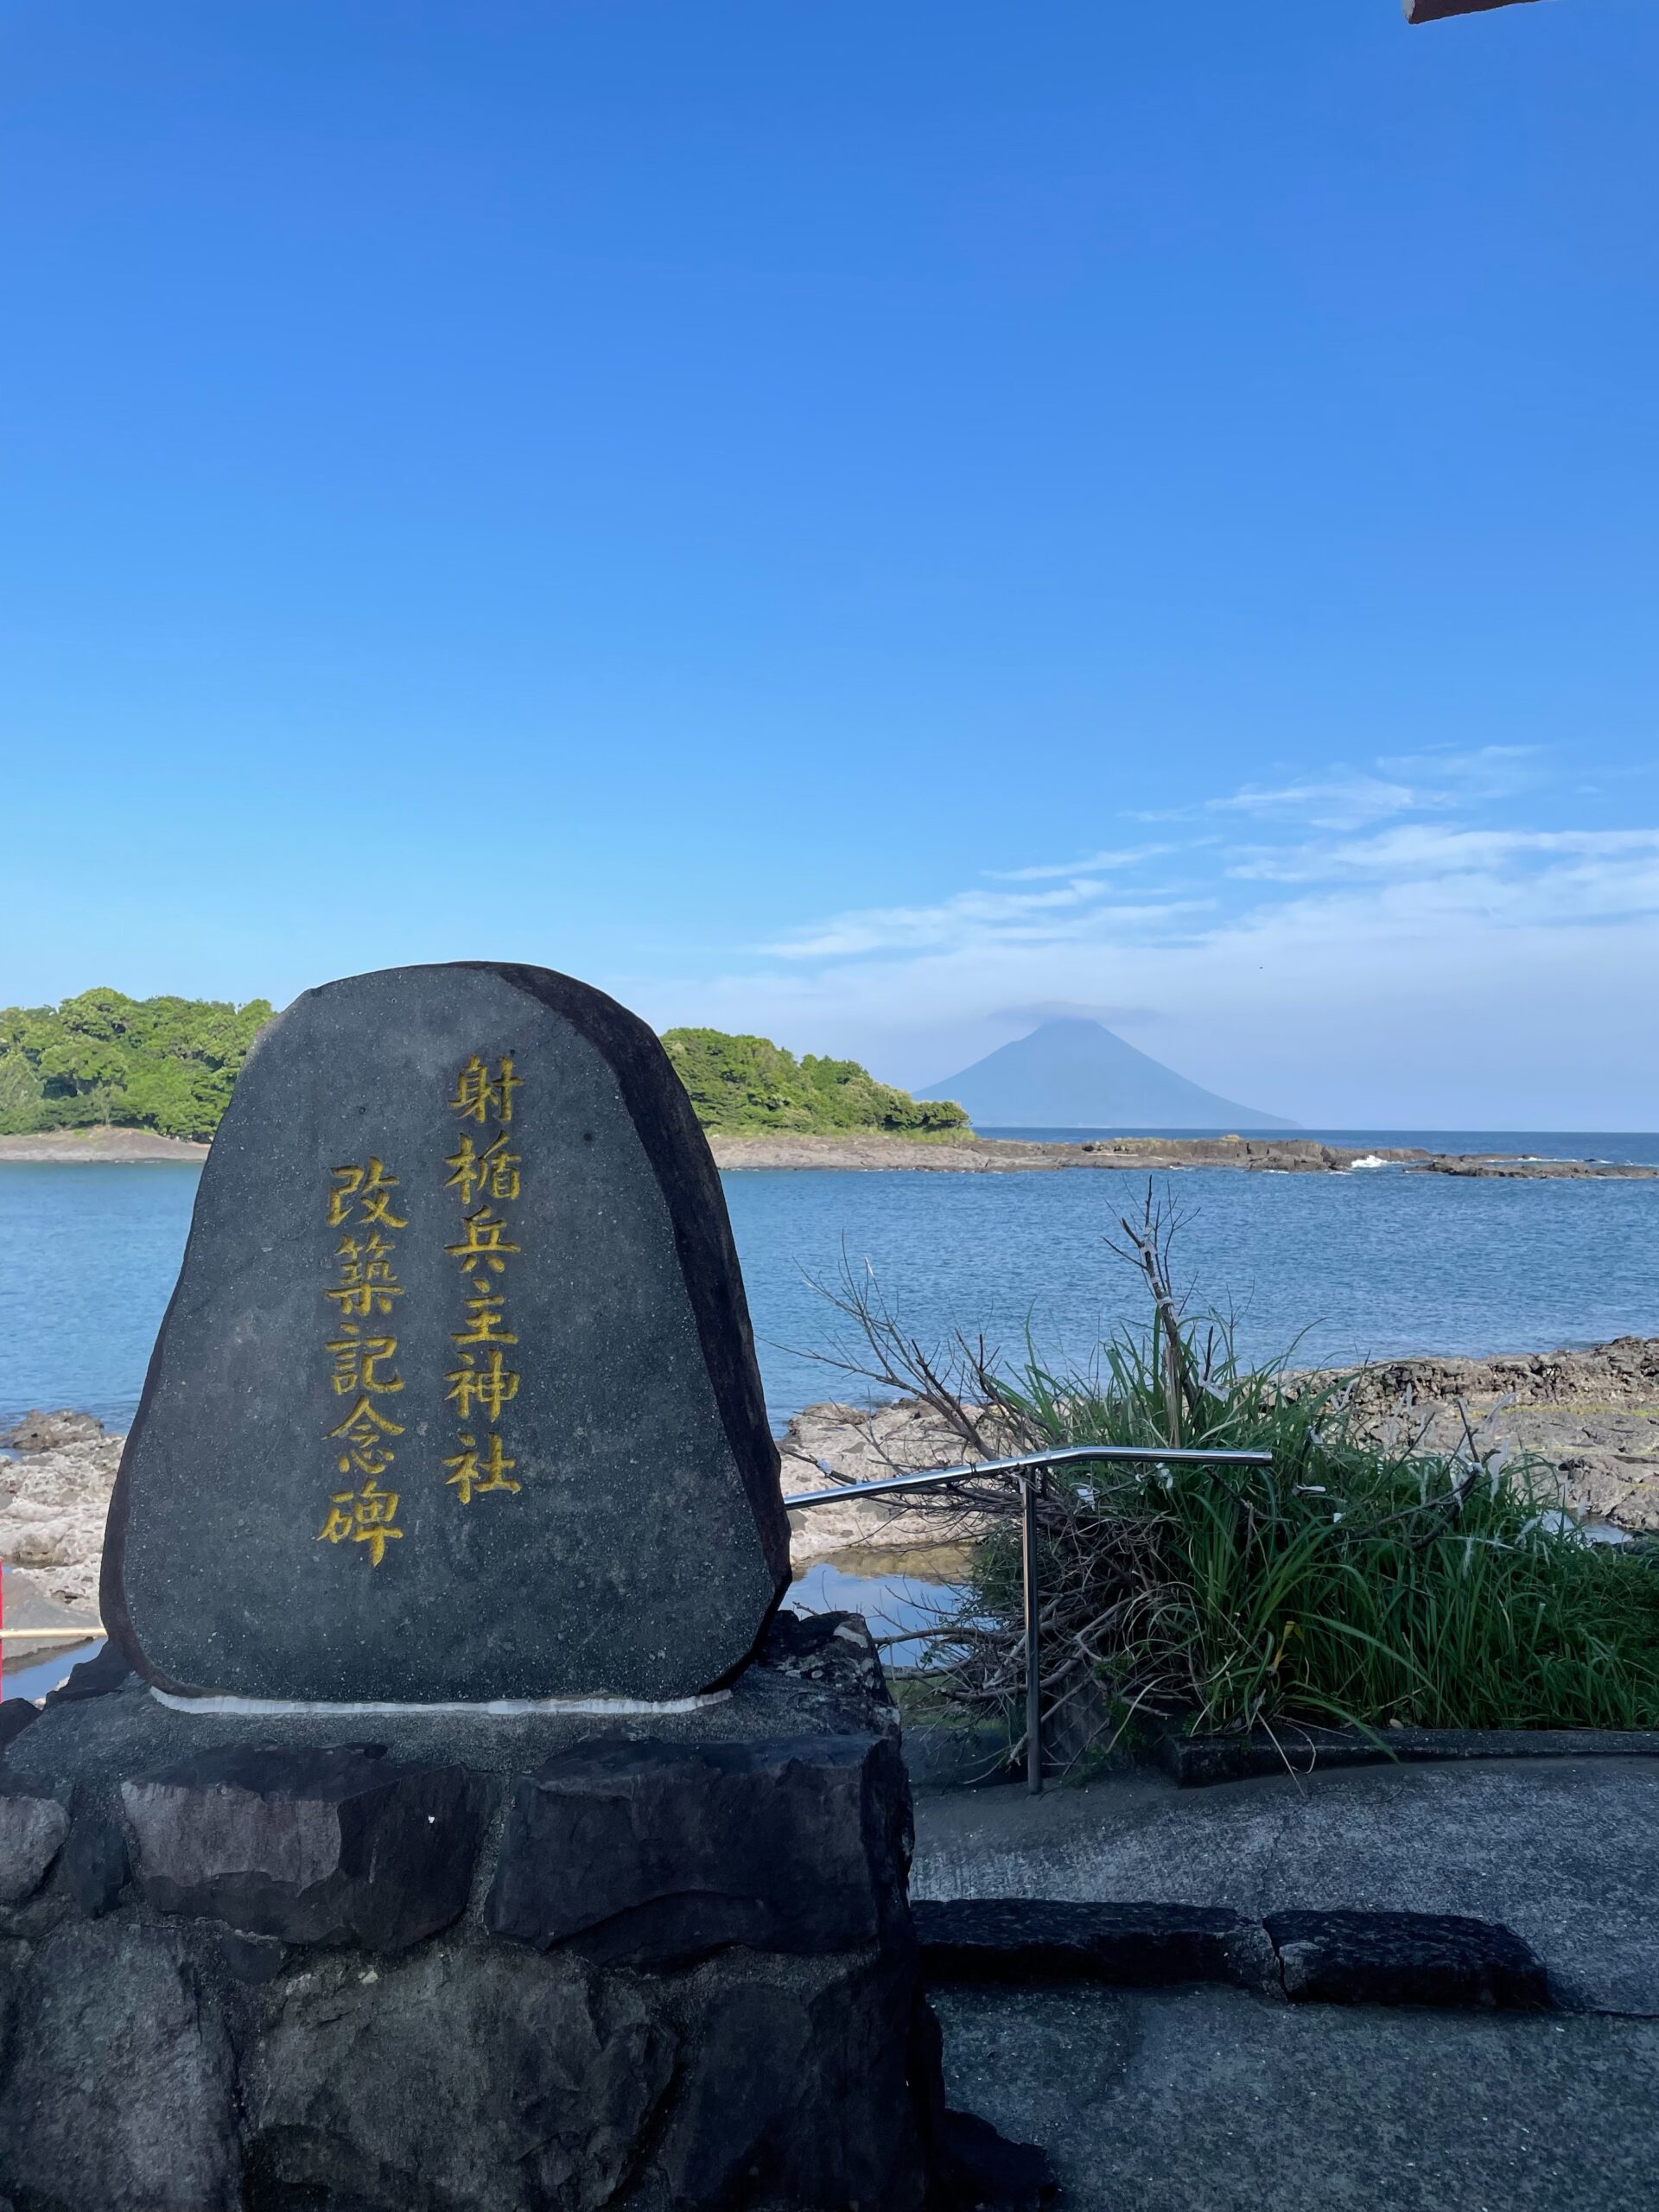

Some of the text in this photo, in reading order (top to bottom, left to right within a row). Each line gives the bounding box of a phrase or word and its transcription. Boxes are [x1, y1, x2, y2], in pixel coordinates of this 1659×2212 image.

[317, 1155, 408, 1567] 改築記念碑
[442, 1054, 524, 1505] 射楯兵主神社
